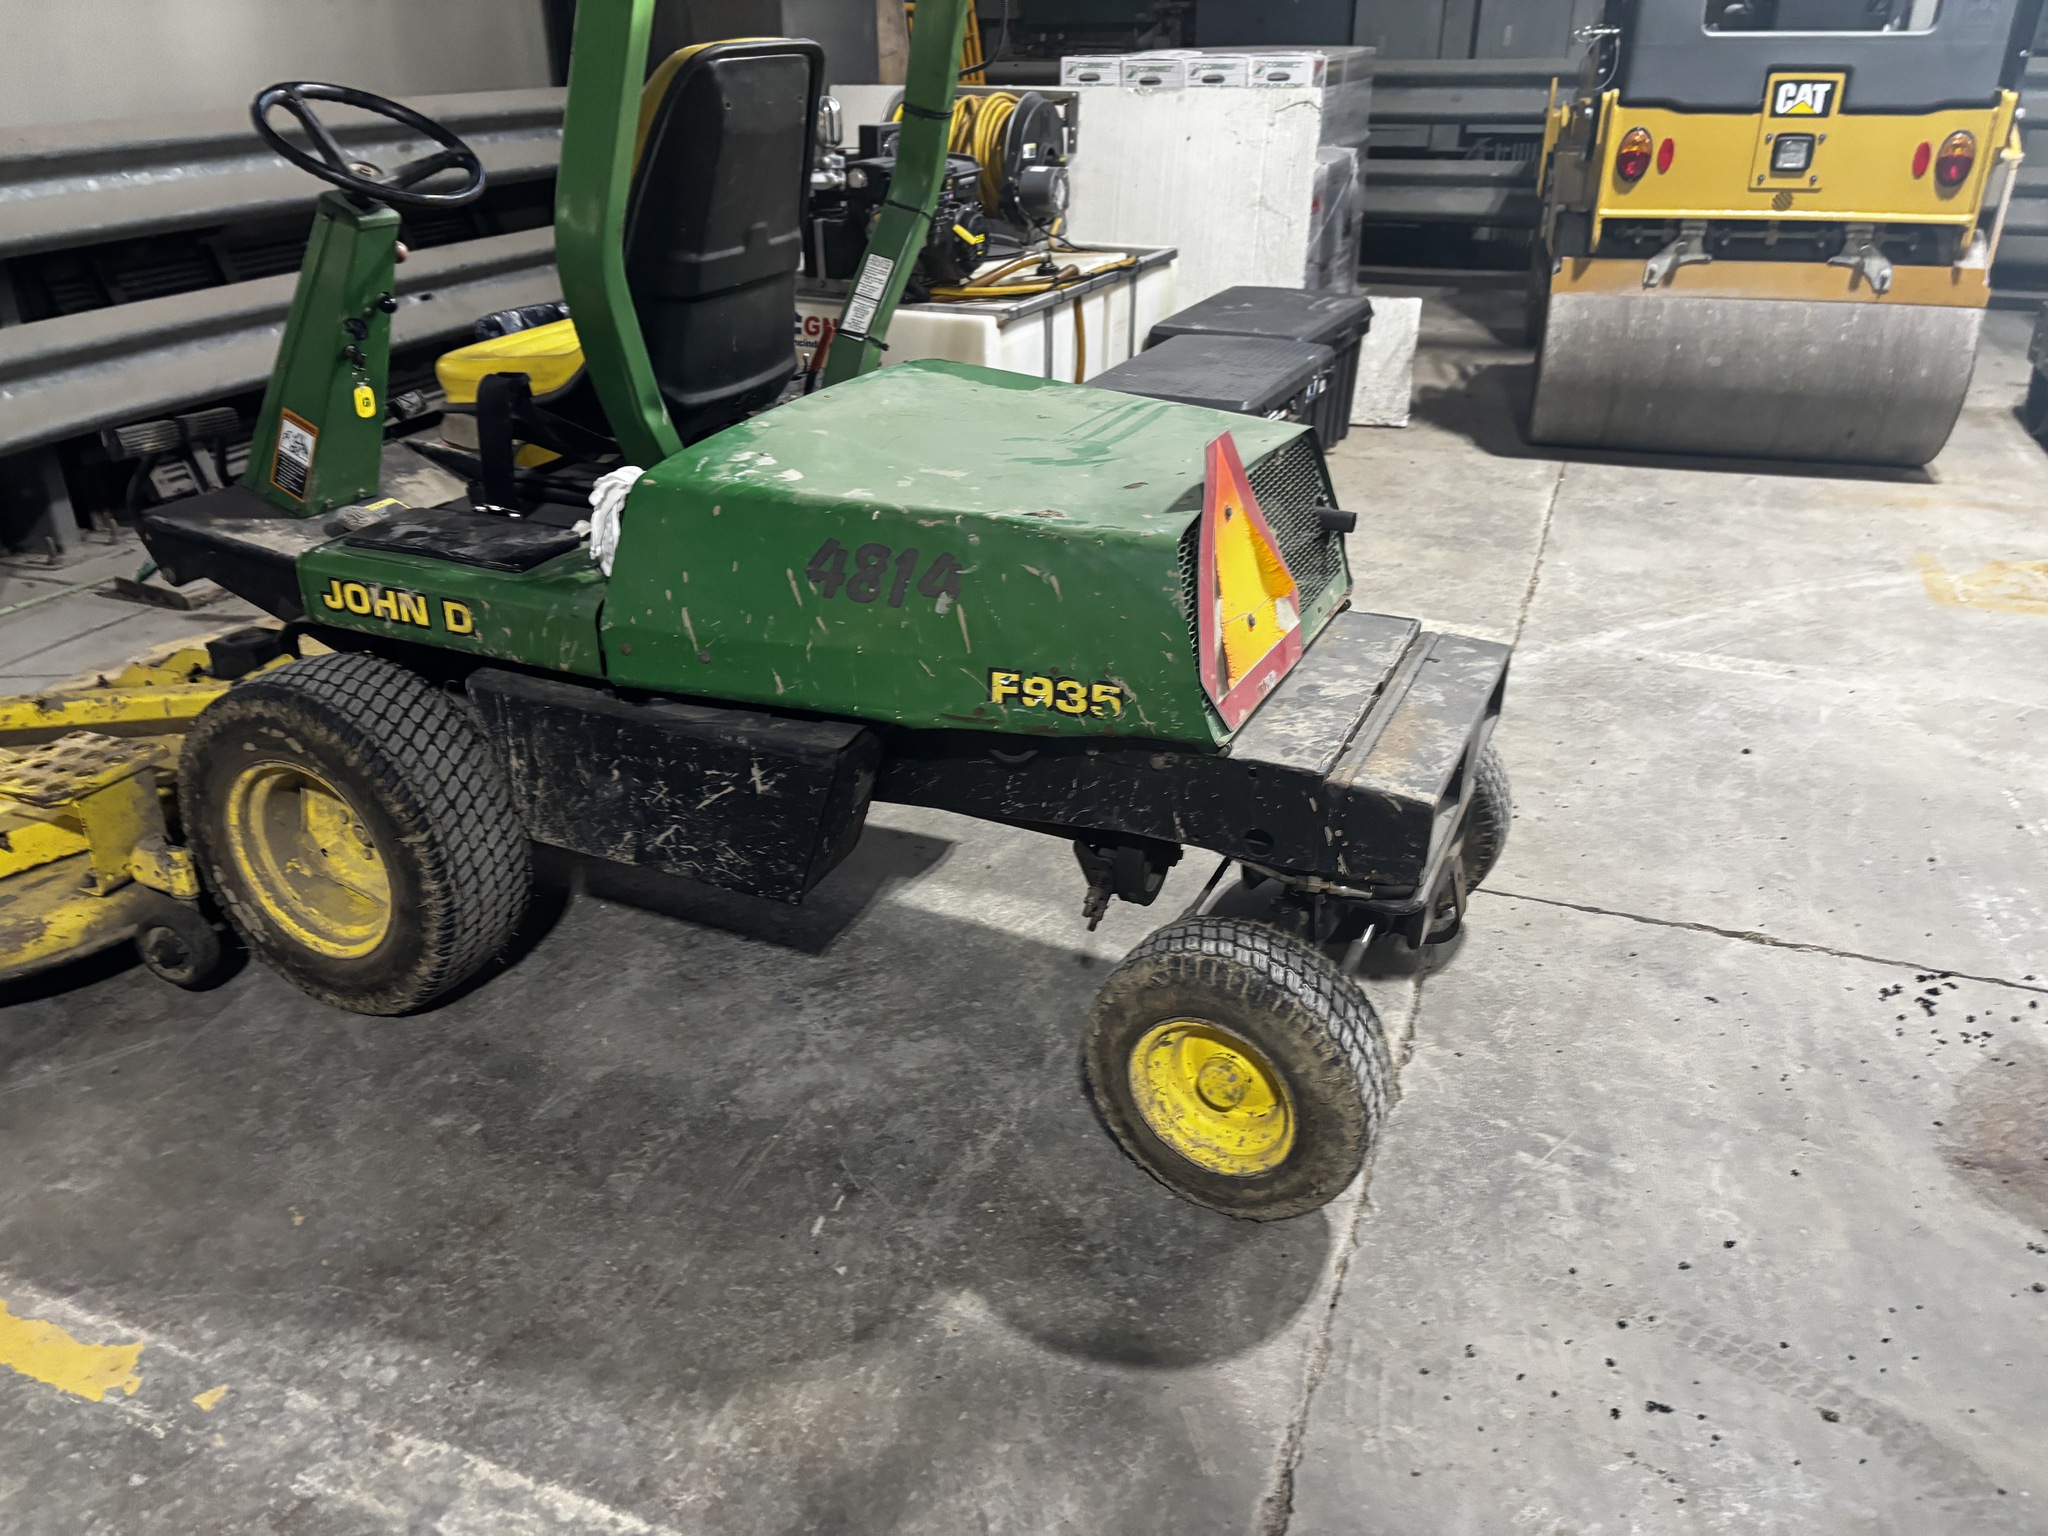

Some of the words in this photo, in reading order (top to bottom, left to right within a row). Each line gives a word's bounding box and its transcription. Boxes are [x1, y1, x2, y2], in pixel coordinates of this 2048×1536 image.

[1775, 83, 1831, 114] CAT
[806, 538, 962, 608] 4814
[322, 579, 430, 627] JOHN
[442, 599, 474, 634] D
[990, 671, 1122, 717] F935
